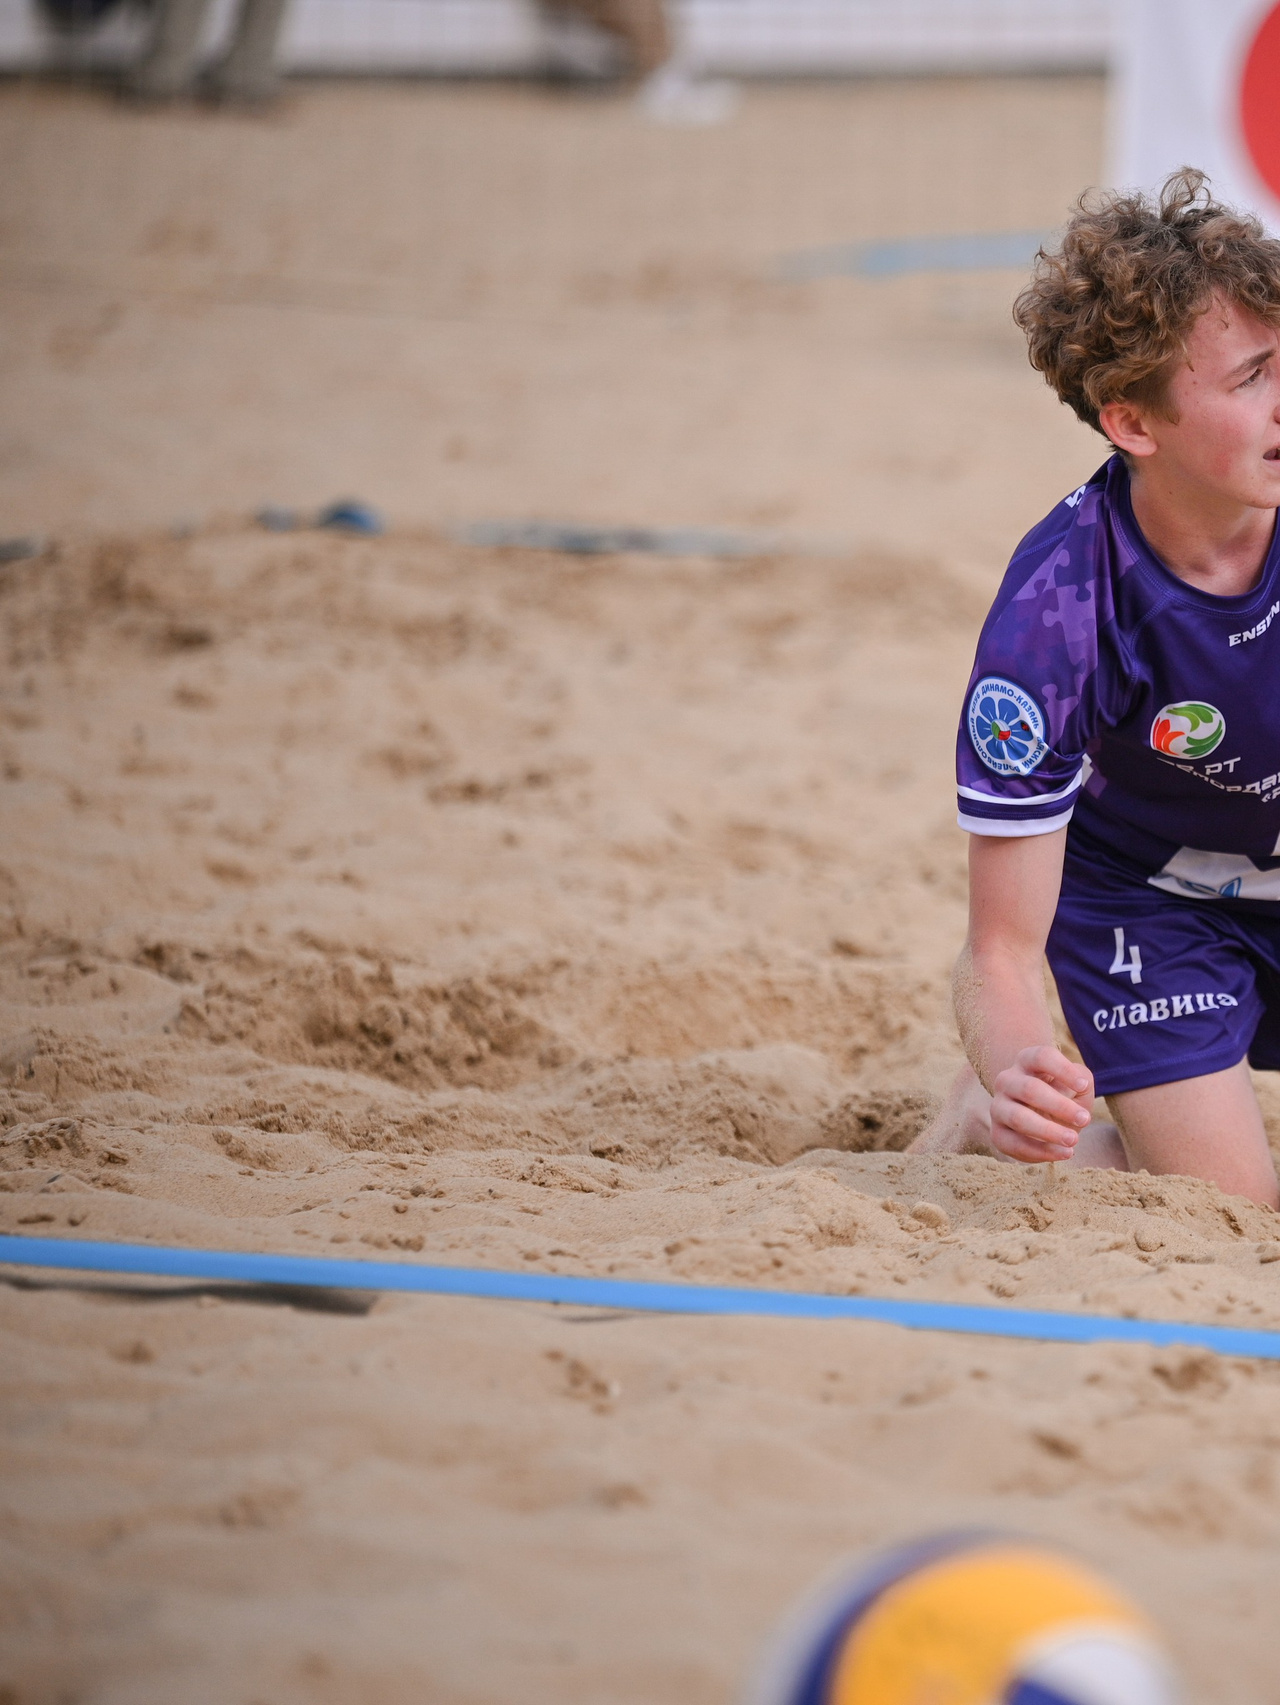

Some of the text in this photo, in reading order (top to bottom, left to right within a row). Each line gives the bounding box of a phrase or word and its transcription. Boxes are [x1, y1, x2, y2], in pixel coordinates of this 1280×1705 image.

[1228, 600, 1280, 647] ENSEN
[981, 682, 1041, 730] ДИНАМО-КАЗАНЬ
[1204, 756, 1241, 776] РТ
[1109, 926, 1143, 985] 4
